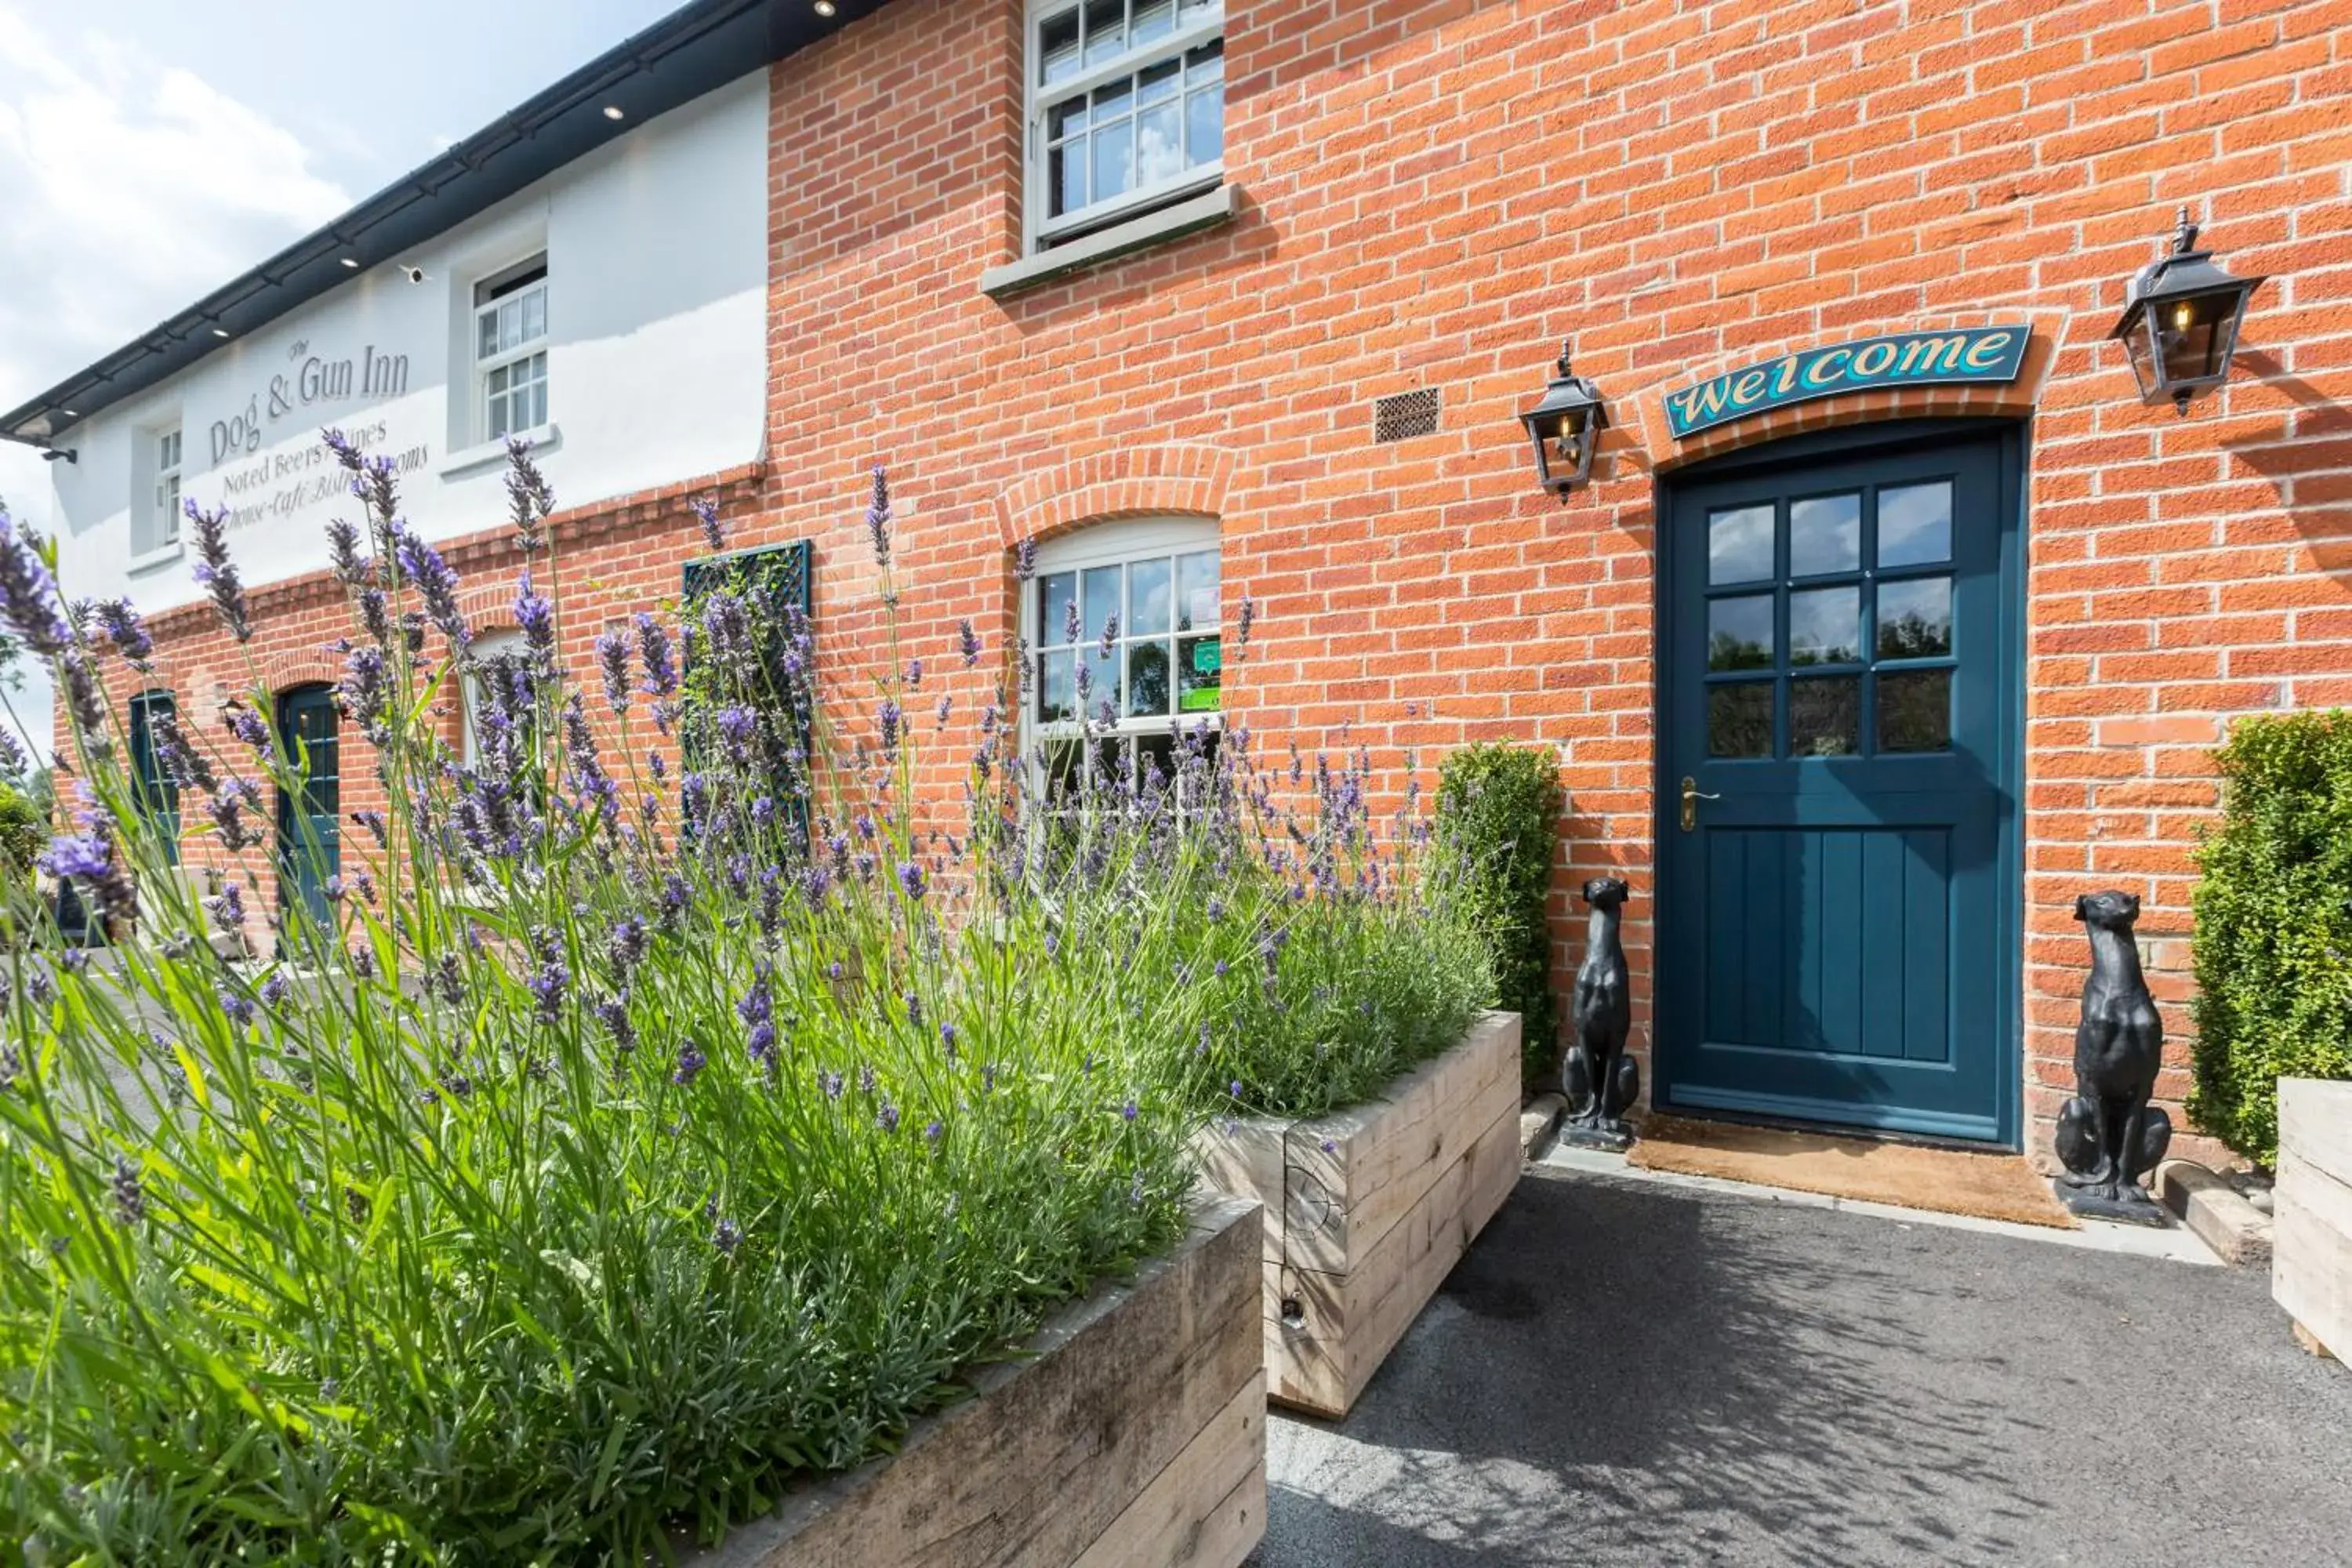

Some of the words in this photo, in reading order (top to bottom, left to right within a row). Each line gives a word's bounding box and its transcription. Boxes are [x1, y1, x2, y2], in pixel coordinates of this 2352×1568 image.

[211, 394, 260, 464] Dog
[268, 374, 291, 419] &
[300, 357, 353, 402] Gun
[362, 345, 408, 394] Inn
[224, 456, 269, 499] Noted
